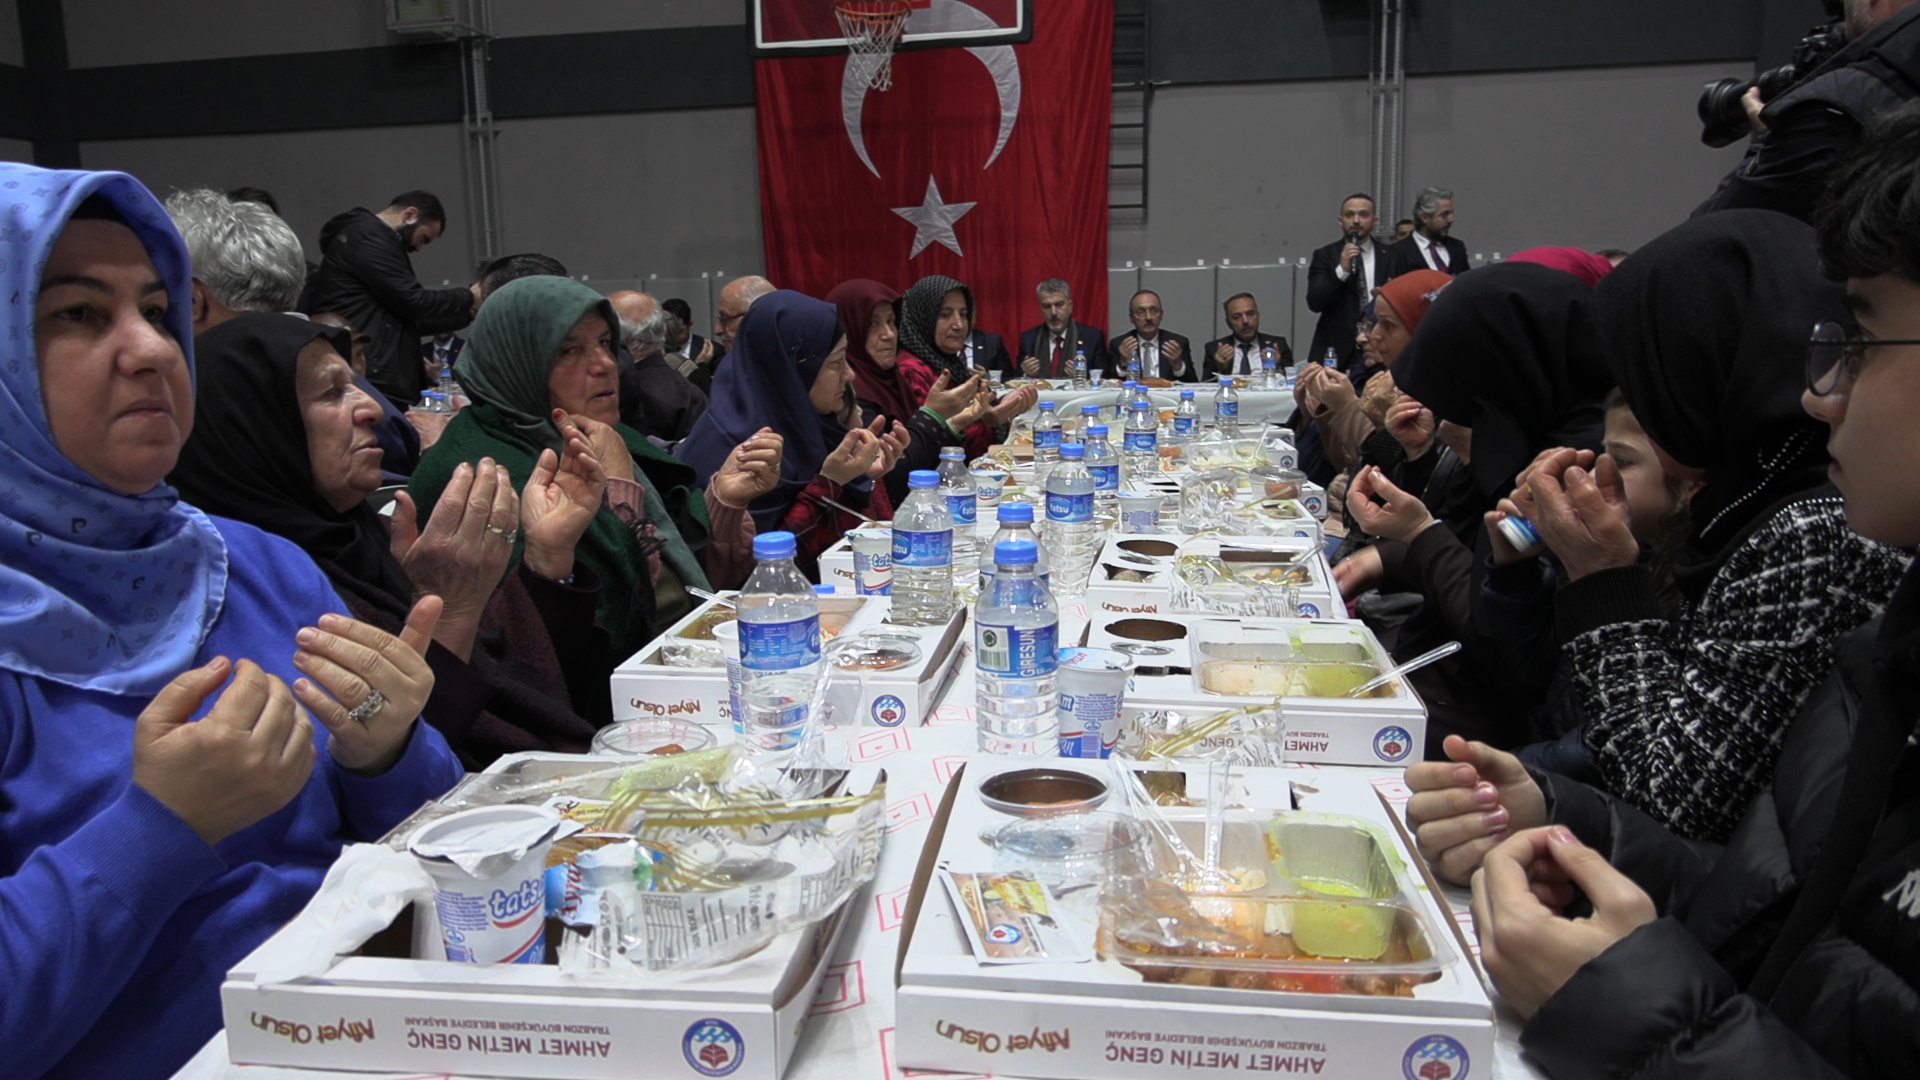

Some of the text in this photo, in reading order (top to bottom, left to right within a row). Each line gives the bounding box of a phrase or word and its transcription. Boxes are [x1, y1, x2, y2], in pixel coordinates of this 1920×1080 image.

[1283, 741, 1329, 752] AHMET
[250, 1010, 376, 1045] Afiyet Olsun
[404, 1016, 448, 1028] BAŞKANI
[564, 1024, 611, 1036] TRABZON
[935, 1019, 1070, 1053] Afiyet Olsun
[1104, 1029, 1152, 1042] BAŞKANI
[407, 1028, 612, 1059] AHMET METİN GENÇ
[1277, 1040, 1327, 1052] TRABZON
[1104, 1041, 1327, 1075] AHMET METİN GENÇ
